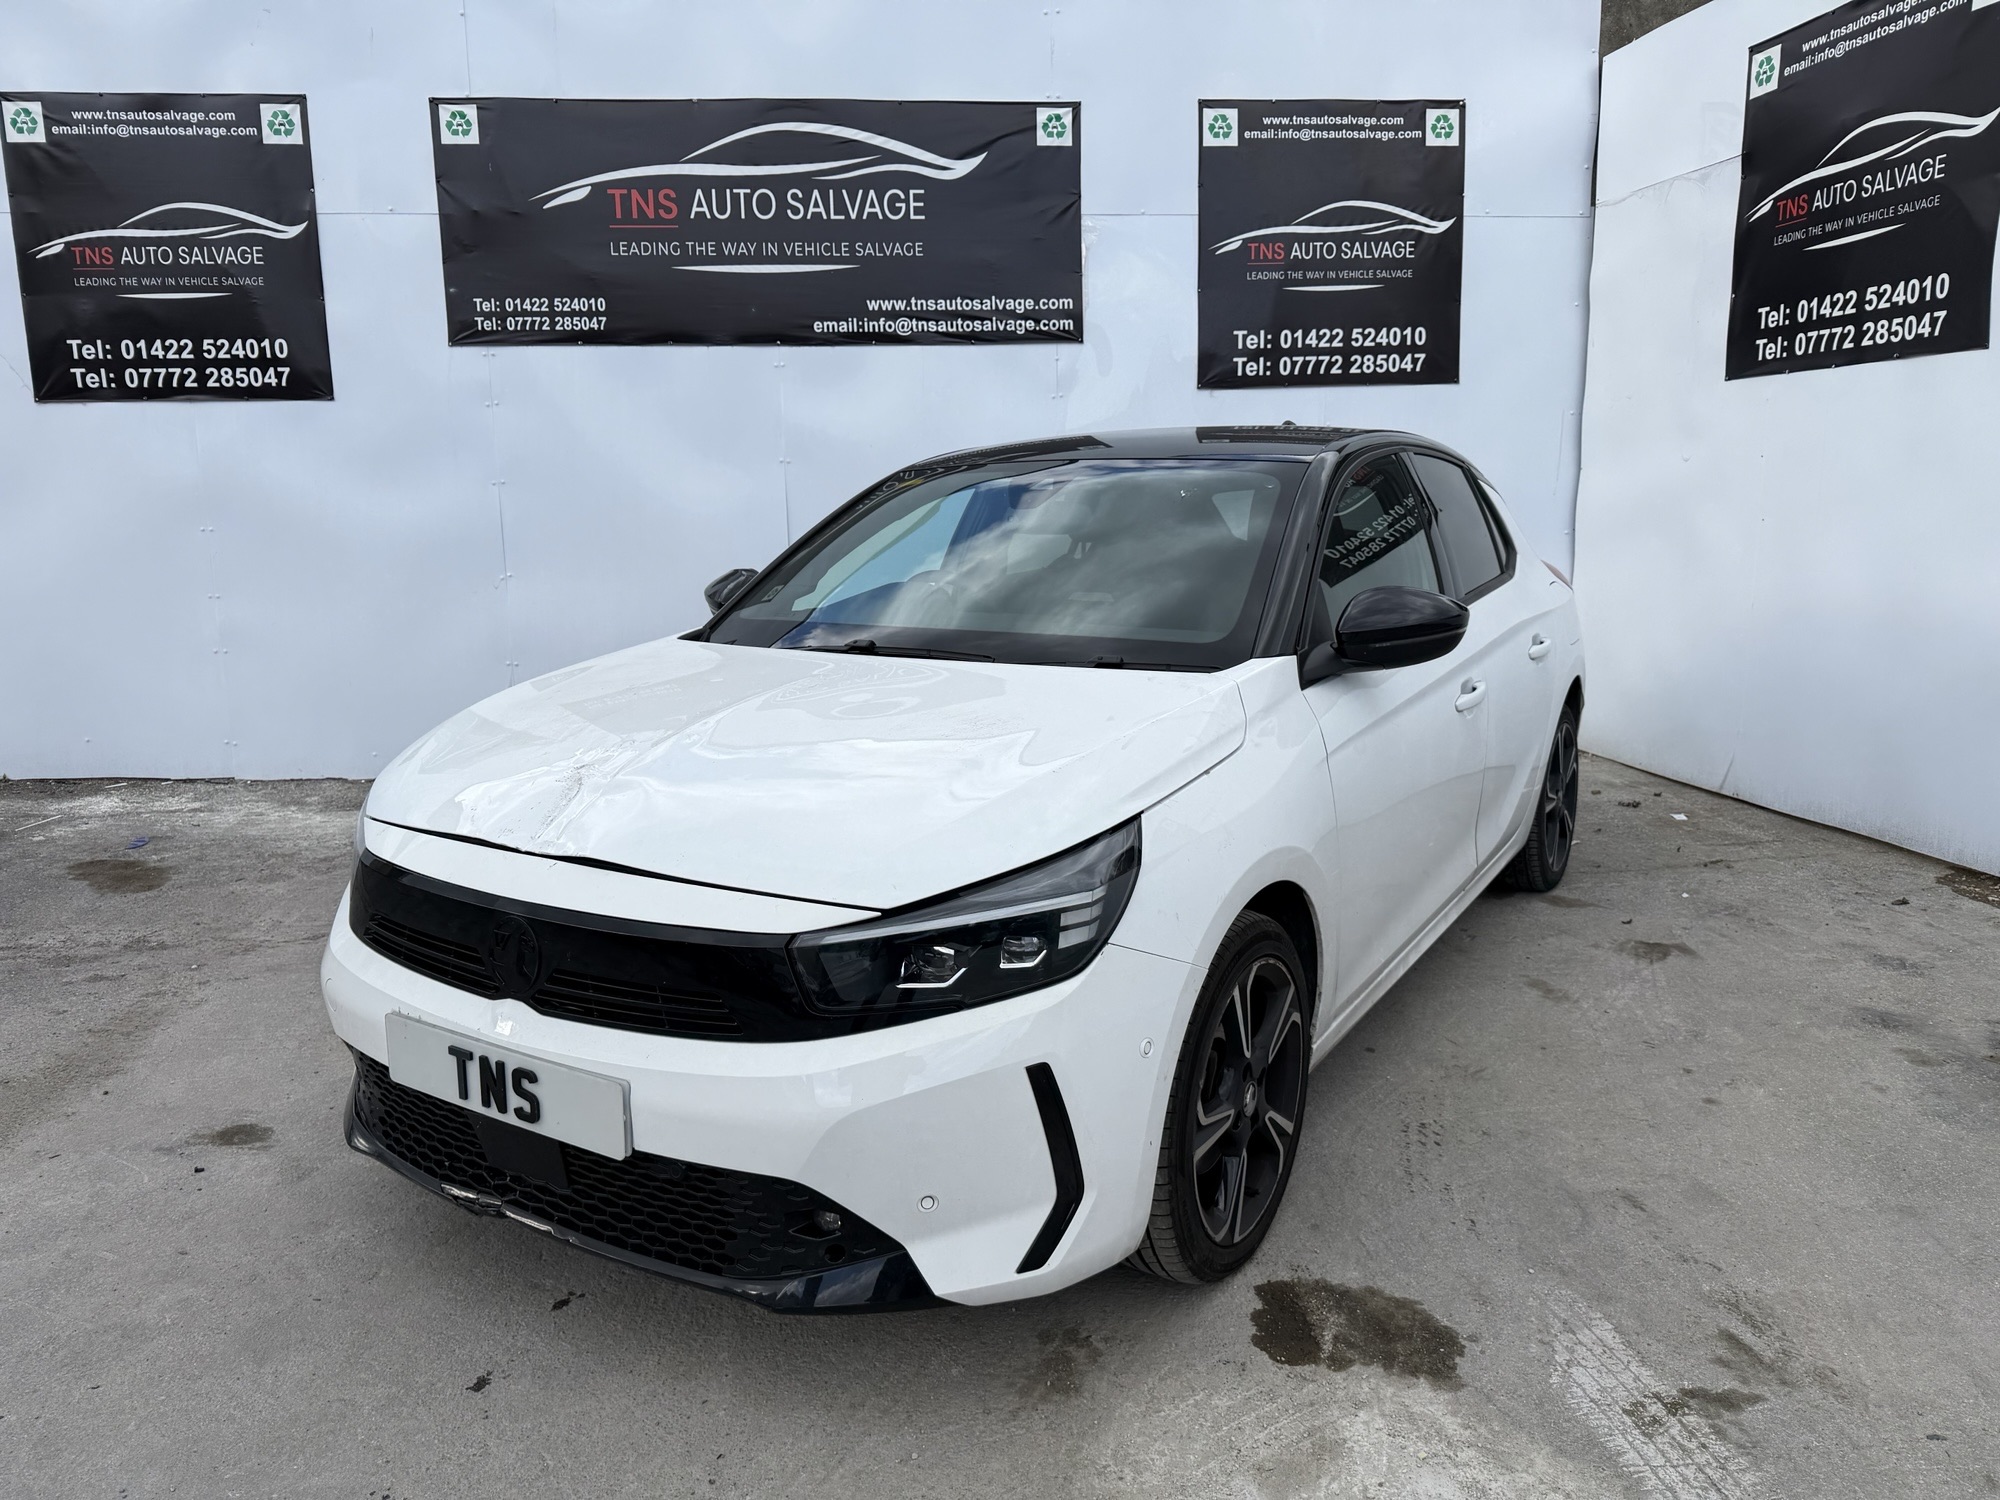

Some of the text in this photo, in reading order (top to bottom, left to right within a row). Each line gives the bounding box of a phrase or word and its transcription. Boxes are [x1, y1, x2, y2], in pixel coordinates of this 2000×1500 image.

[72, 110, 236, 123] www.tnsautosalvage.com
[1262, 115, 1404, 127] www.tnsautosalvage.com
[52, 124, 258, 137] email:info@tnsautosalvage.com
[1244, 129, 1422, 141] email:info@tnsautosalvage.com
[1776, 154, 1947, 221] TNS AUTO SALVAGE
[607, 188, 926, 220] TNS AUTO SALVAGE
[1774, 195, 1941, 246] LEADING THE WAY IN VEHICLE SALVAGE
[71, 247, 264, 265] TNS AUTO SALVAGE
[610, 241, 924, 256] LEADING THE WAY IN VEHICLE SALVAGE
[1248, 241, 1415, 260] TNS AUTO SALVAGE
[74, 276, 264, 287] LEADING THE WAY IN VEHICLE SALVAGE
[1247, 270, 1413, 280] LEADING THE WAY IN VEHICLE SALVAGE
[473, 298, 606, 312] Tel: 01422 524010
[866, 296, 1073, 313] www.tnsautosalvage.com
[1758, 272, 1950, 330] Tel: 01422 524010
[474, 317, 607, 331] Tel: 07772 285047
[813, 317, 1074, 336] email:info@tnsautosalvage.com
[1233, 326, 1426, 349] Tel: 01422 524010
[1755, 310, 1947, 361] Tel: 07772 285047
[67, 338, 288, 359] Tel: 01422 524010
[1233, 353, 1426, 376] Tel: 07772 285047
[70, 367, 290, 388] Tel: 07772 285047
[448, 1044, 541, 1124] TNS
